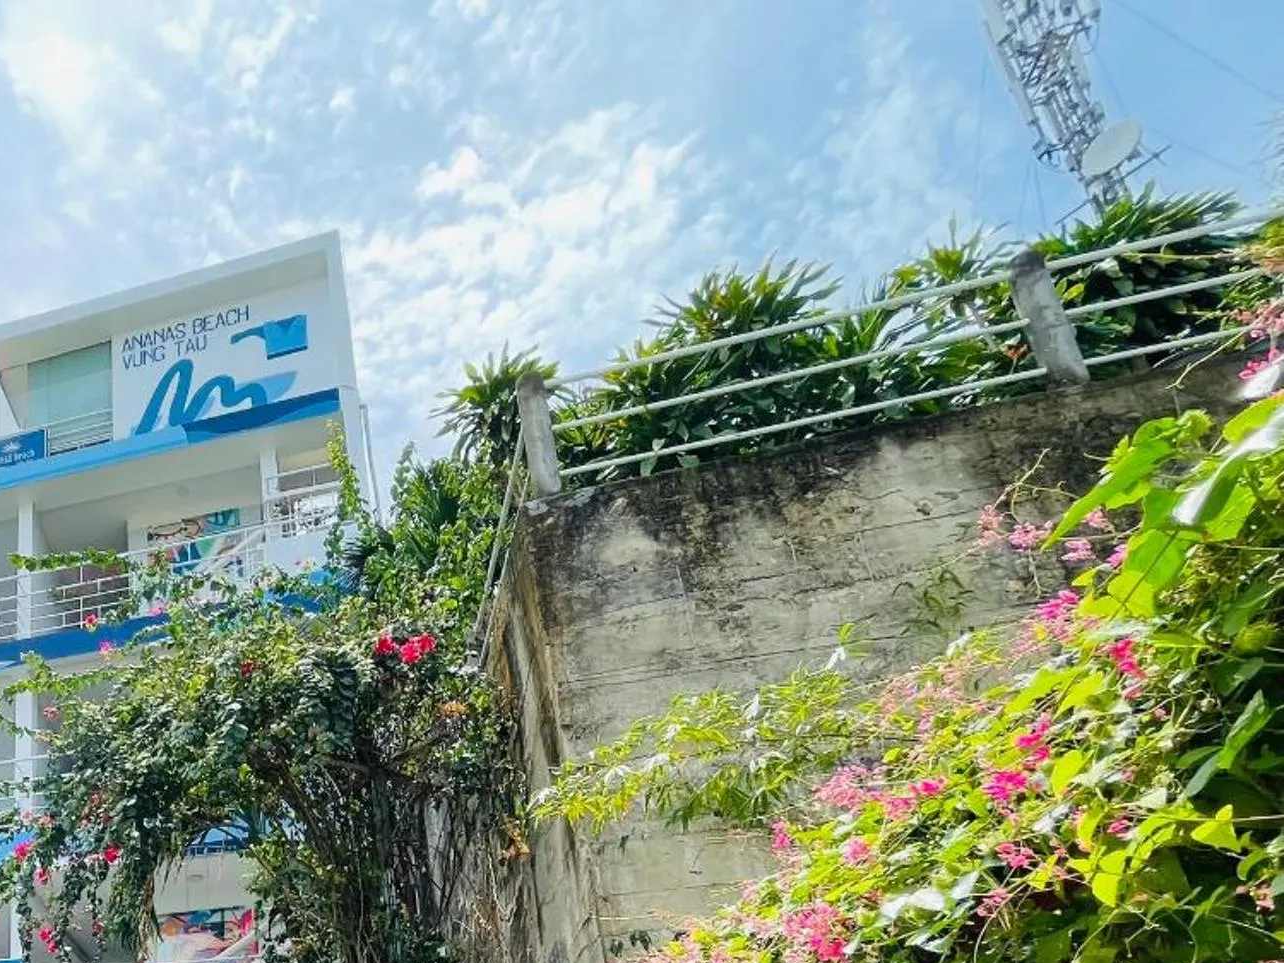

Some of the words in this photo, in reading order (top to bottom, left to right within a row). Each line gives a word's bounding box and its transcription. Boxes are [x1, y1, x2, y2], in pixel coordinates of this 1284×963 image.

[122, 322, 186, 352] ANANAS
[193, 304, 249, 334] BEACH
[175, 335, 208, 357] TAU
